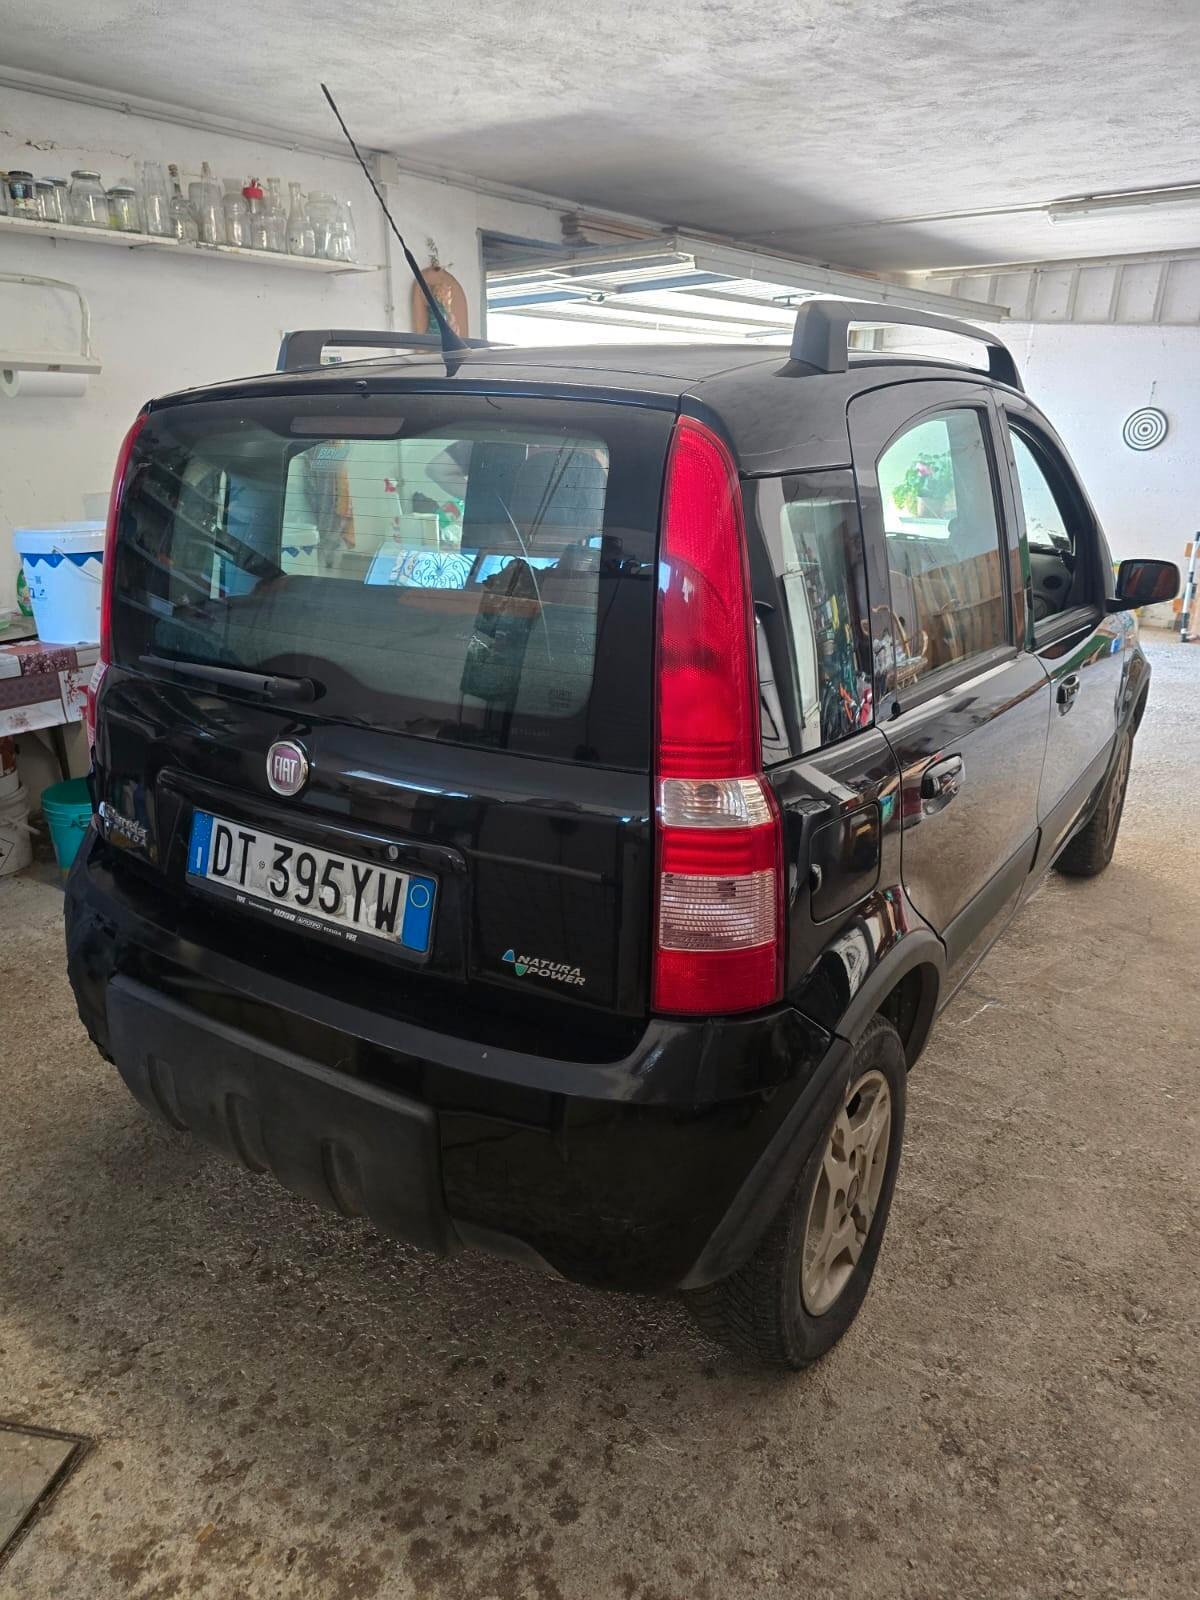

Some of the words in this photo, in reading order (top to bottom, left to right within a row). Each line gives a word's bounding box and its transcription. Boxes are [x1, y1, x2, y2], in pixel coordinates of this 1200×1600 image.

[274, 755, 298, 784] FIAT
[212, 824, 257, 887] DT
[269, 843, 403, 934] 395YW
[516, 955, 581, 976] NATURA
[526, 966, 586, 986] POWER
